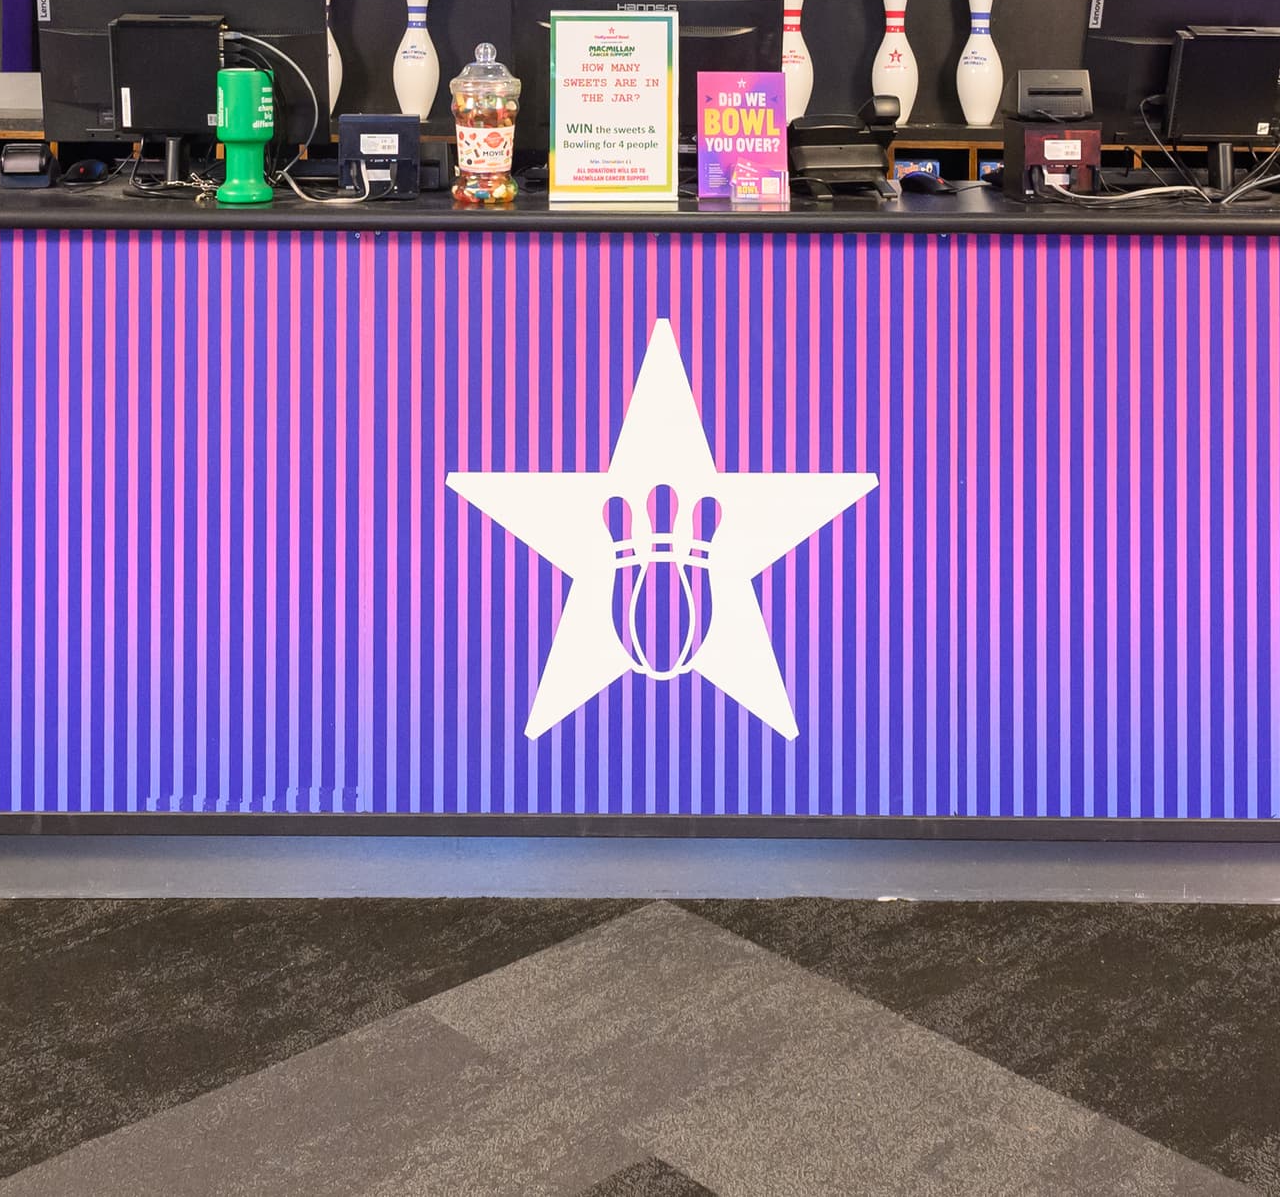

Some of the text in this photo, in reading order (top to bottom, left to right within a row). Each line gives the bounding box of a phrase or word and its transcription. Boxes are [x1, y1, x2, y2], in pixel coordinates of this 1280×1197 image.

[581, 63, 641, 73] HOW MANY
[563, 78, 660, 88] SWEETS ARE IN
[581, 93, 641, 103] THE JAR?
[745, 92, 767, 107] WE
[703, 108, 781, 137] BOWL
[566, 123, 656, 135] WIN the sweets &
[563, 140, 659, 151] Bowling for 4 people
[705, 138, 781, 153] YOU OVER?
